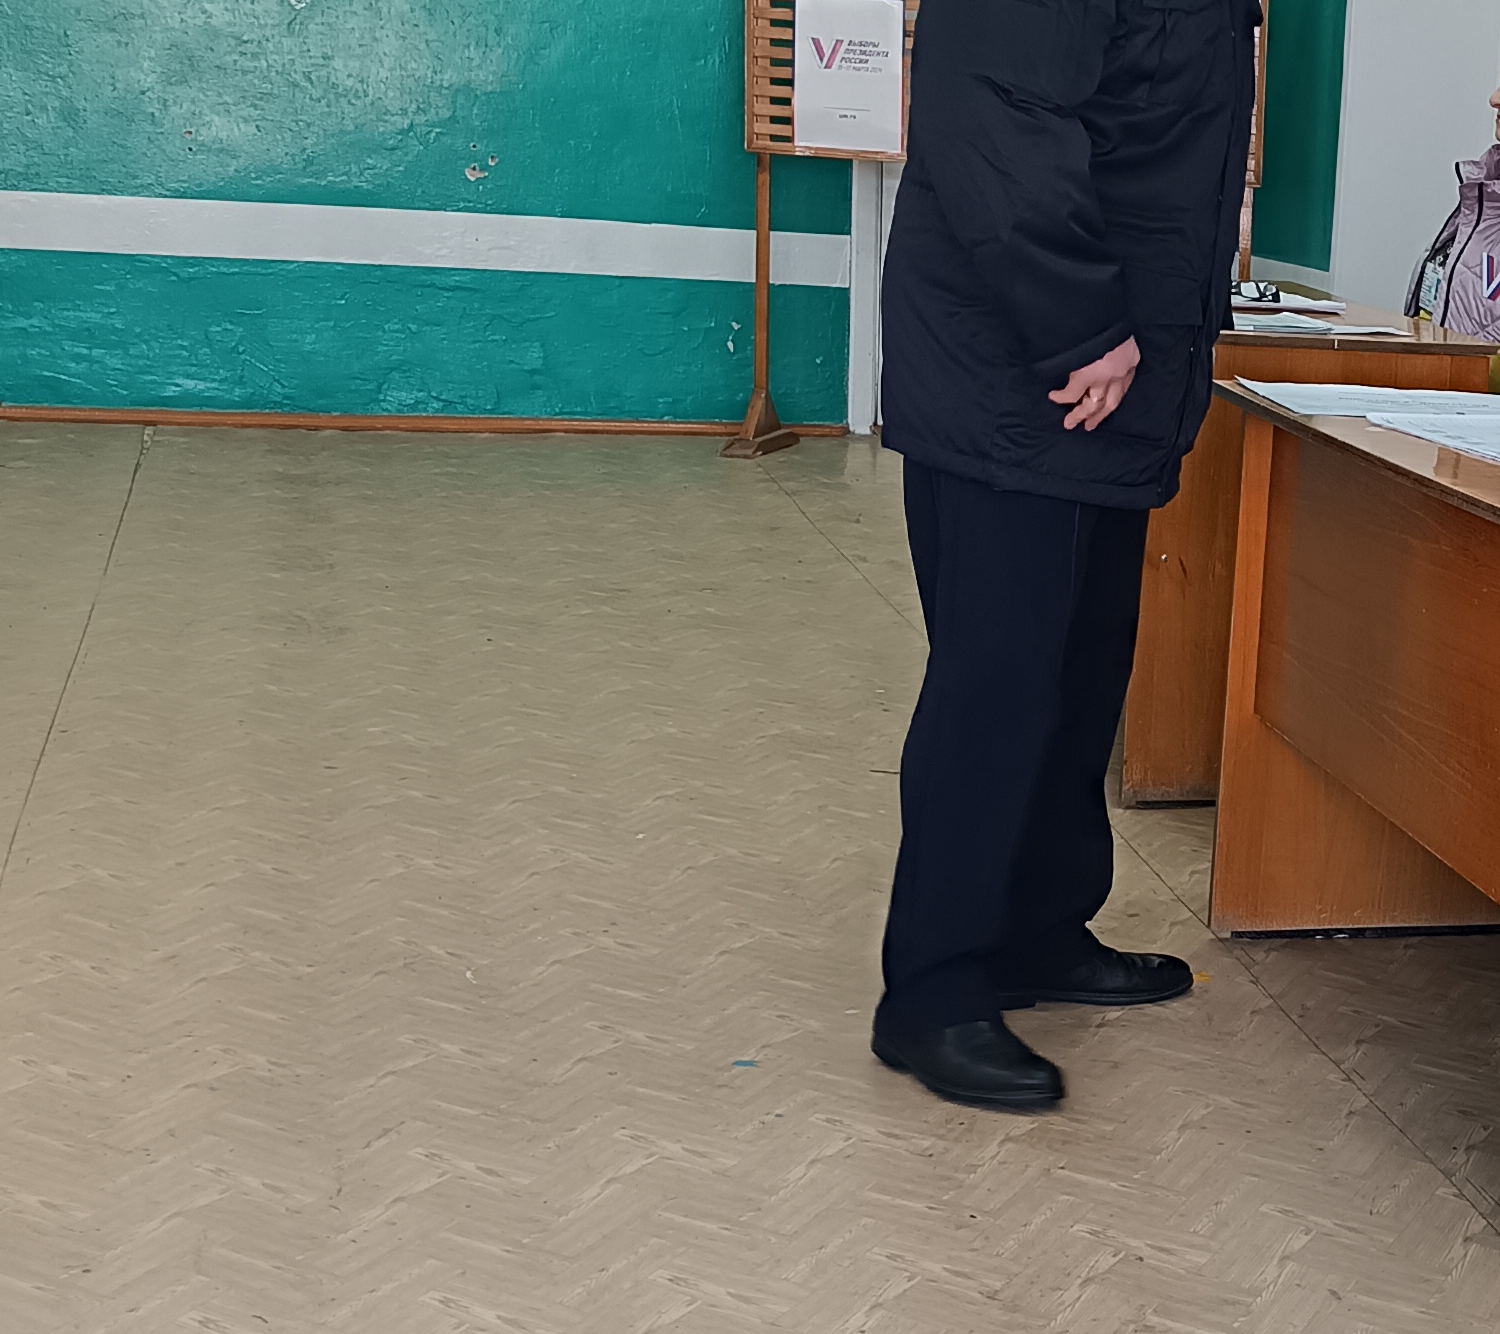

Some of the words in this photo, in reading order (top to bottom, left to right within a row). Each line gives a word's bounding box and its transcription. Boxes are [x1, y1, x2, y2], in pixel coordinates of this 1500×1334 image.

[847, 40, 880, 48] ВЫБОРЫ
[843, 48, 889, 58] ПРЕЗИДЕНТА
[839, 57, 870, 65] РОССИИ
